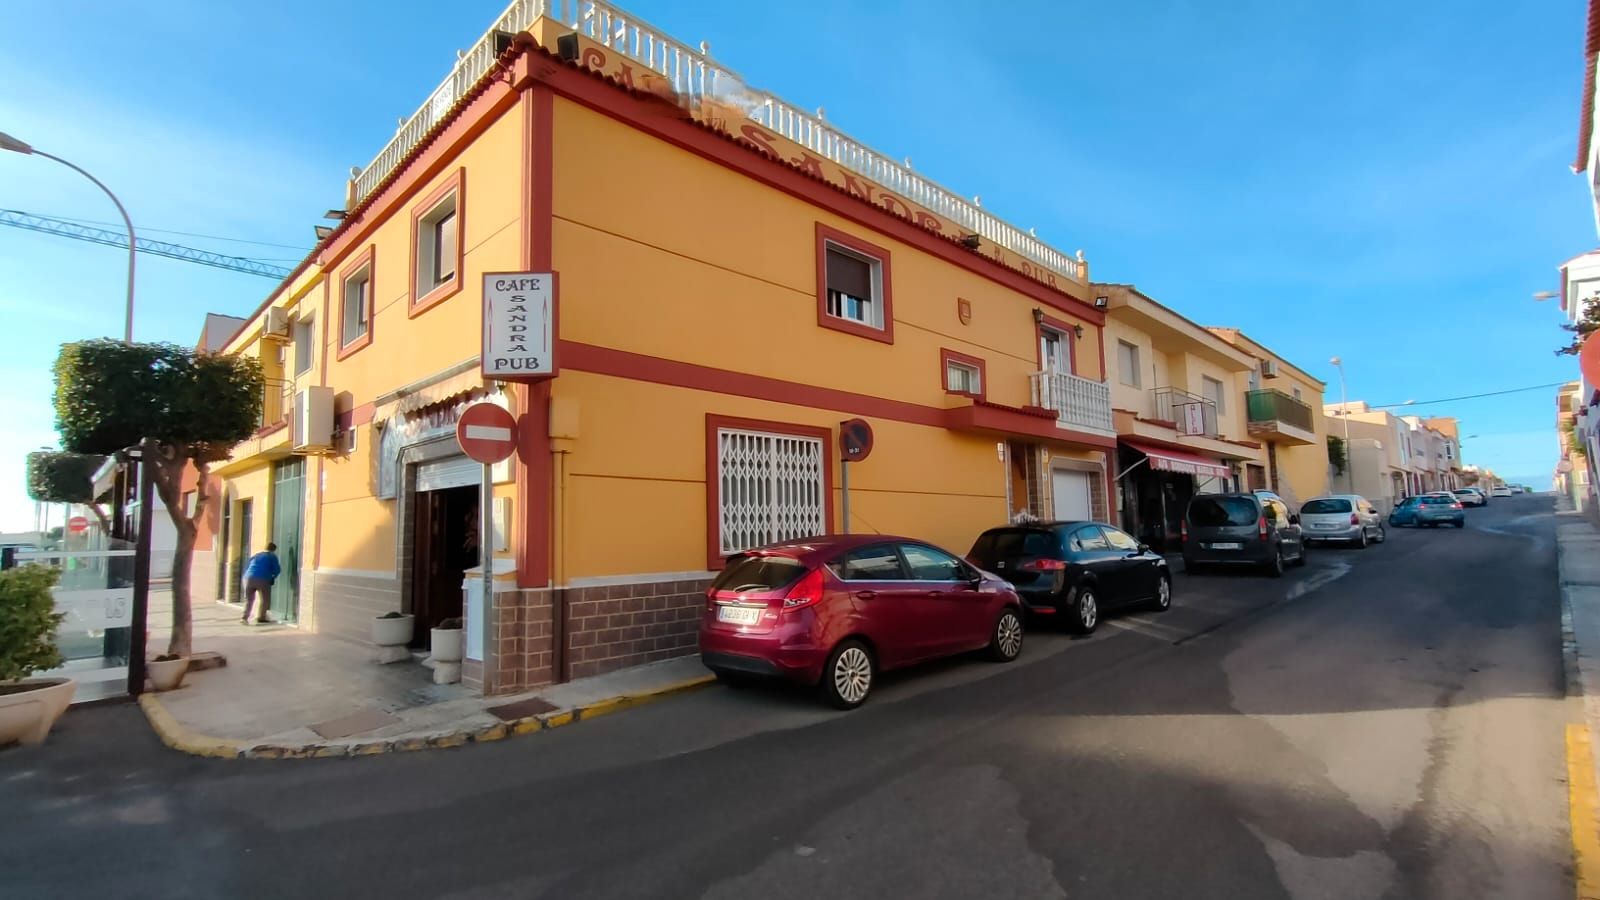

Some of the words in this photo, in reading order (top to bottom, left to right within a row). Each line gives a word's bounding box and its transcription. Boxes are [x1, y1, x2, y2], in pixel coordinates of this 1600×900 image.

[495, 279, 541, 292] CAFE
[506, 294, 529, 352] SANDRA
[494, 357, 540, 370] PUB
